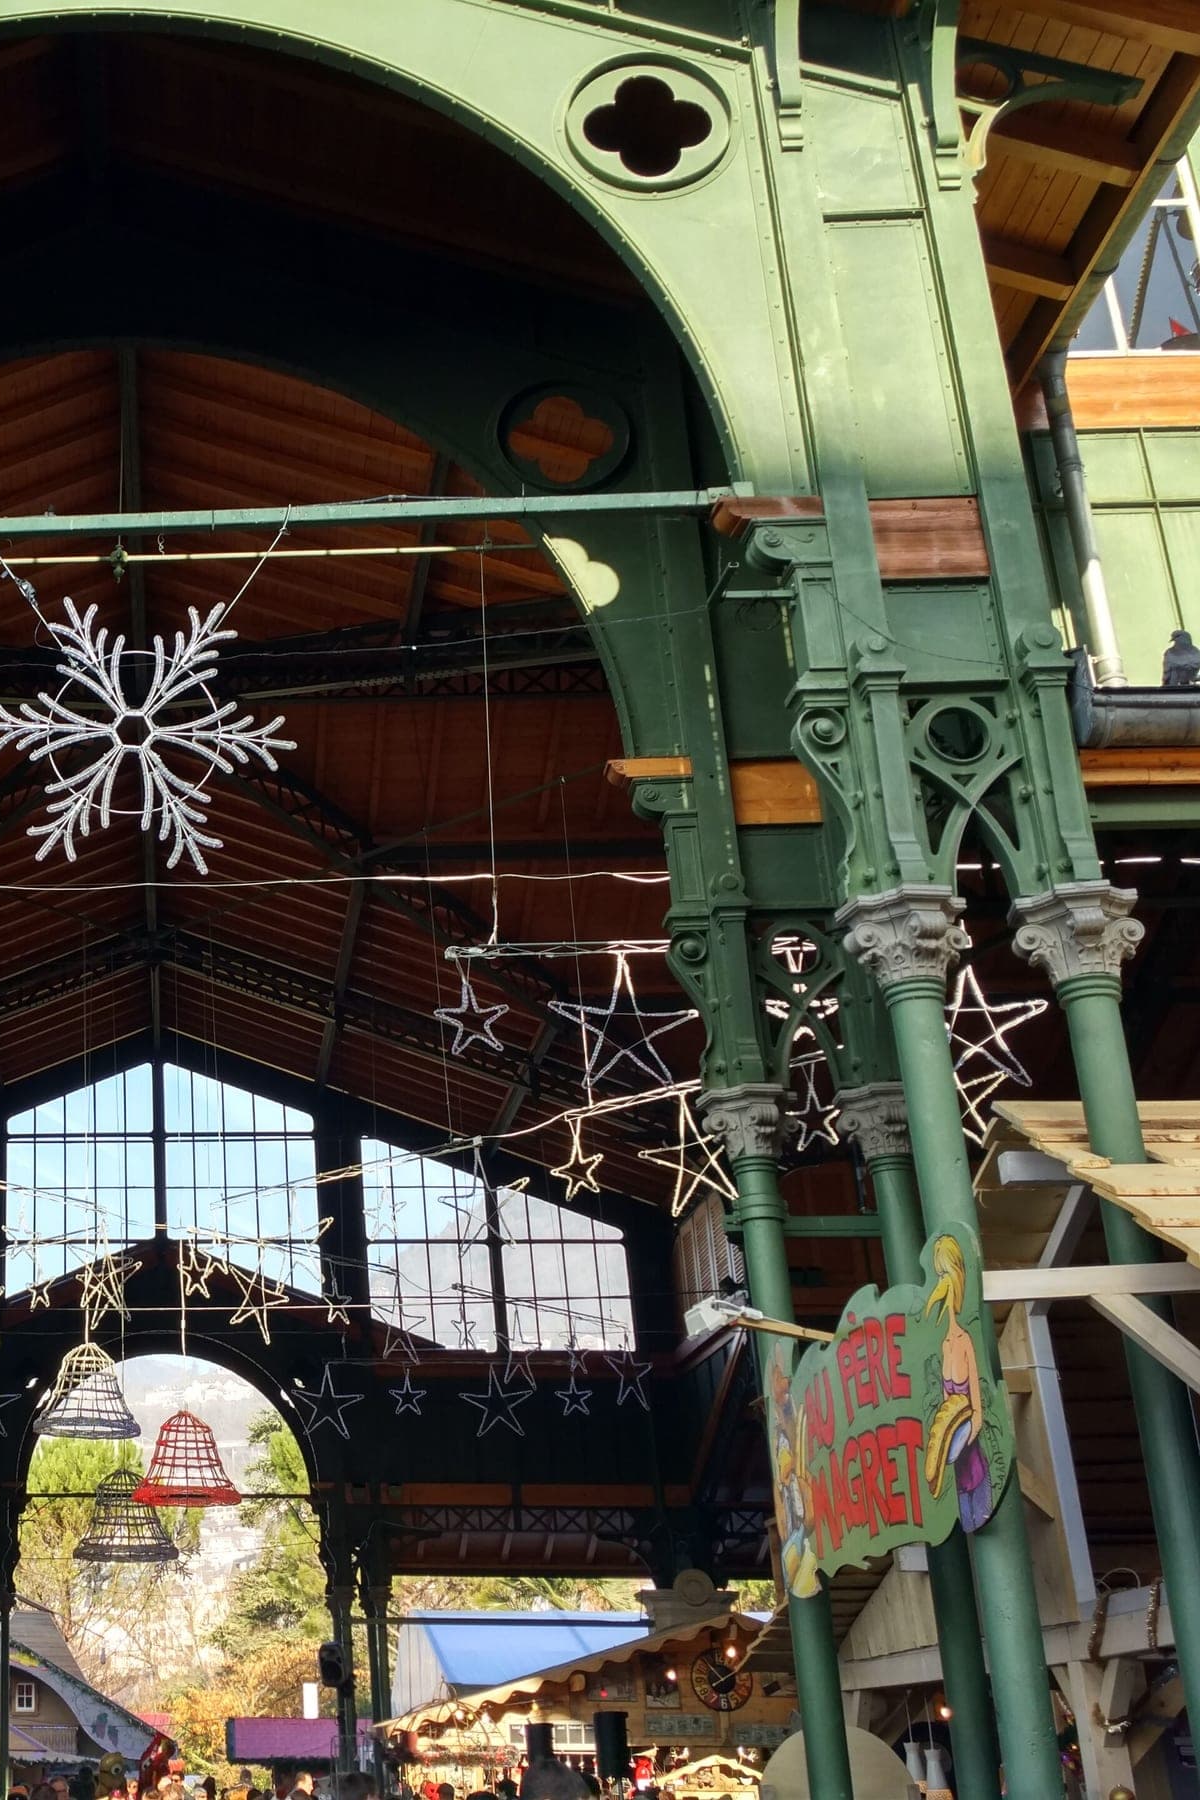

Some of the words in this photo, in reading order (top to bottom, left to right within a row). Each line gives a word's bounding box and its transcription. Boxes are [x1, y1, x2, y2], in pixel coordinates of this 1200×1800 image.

[804, 1366, 836, 1462] AU
[836, 1311, 912, 1427] PÈRE
[811, 1416, 925, 1560] MAGRET
